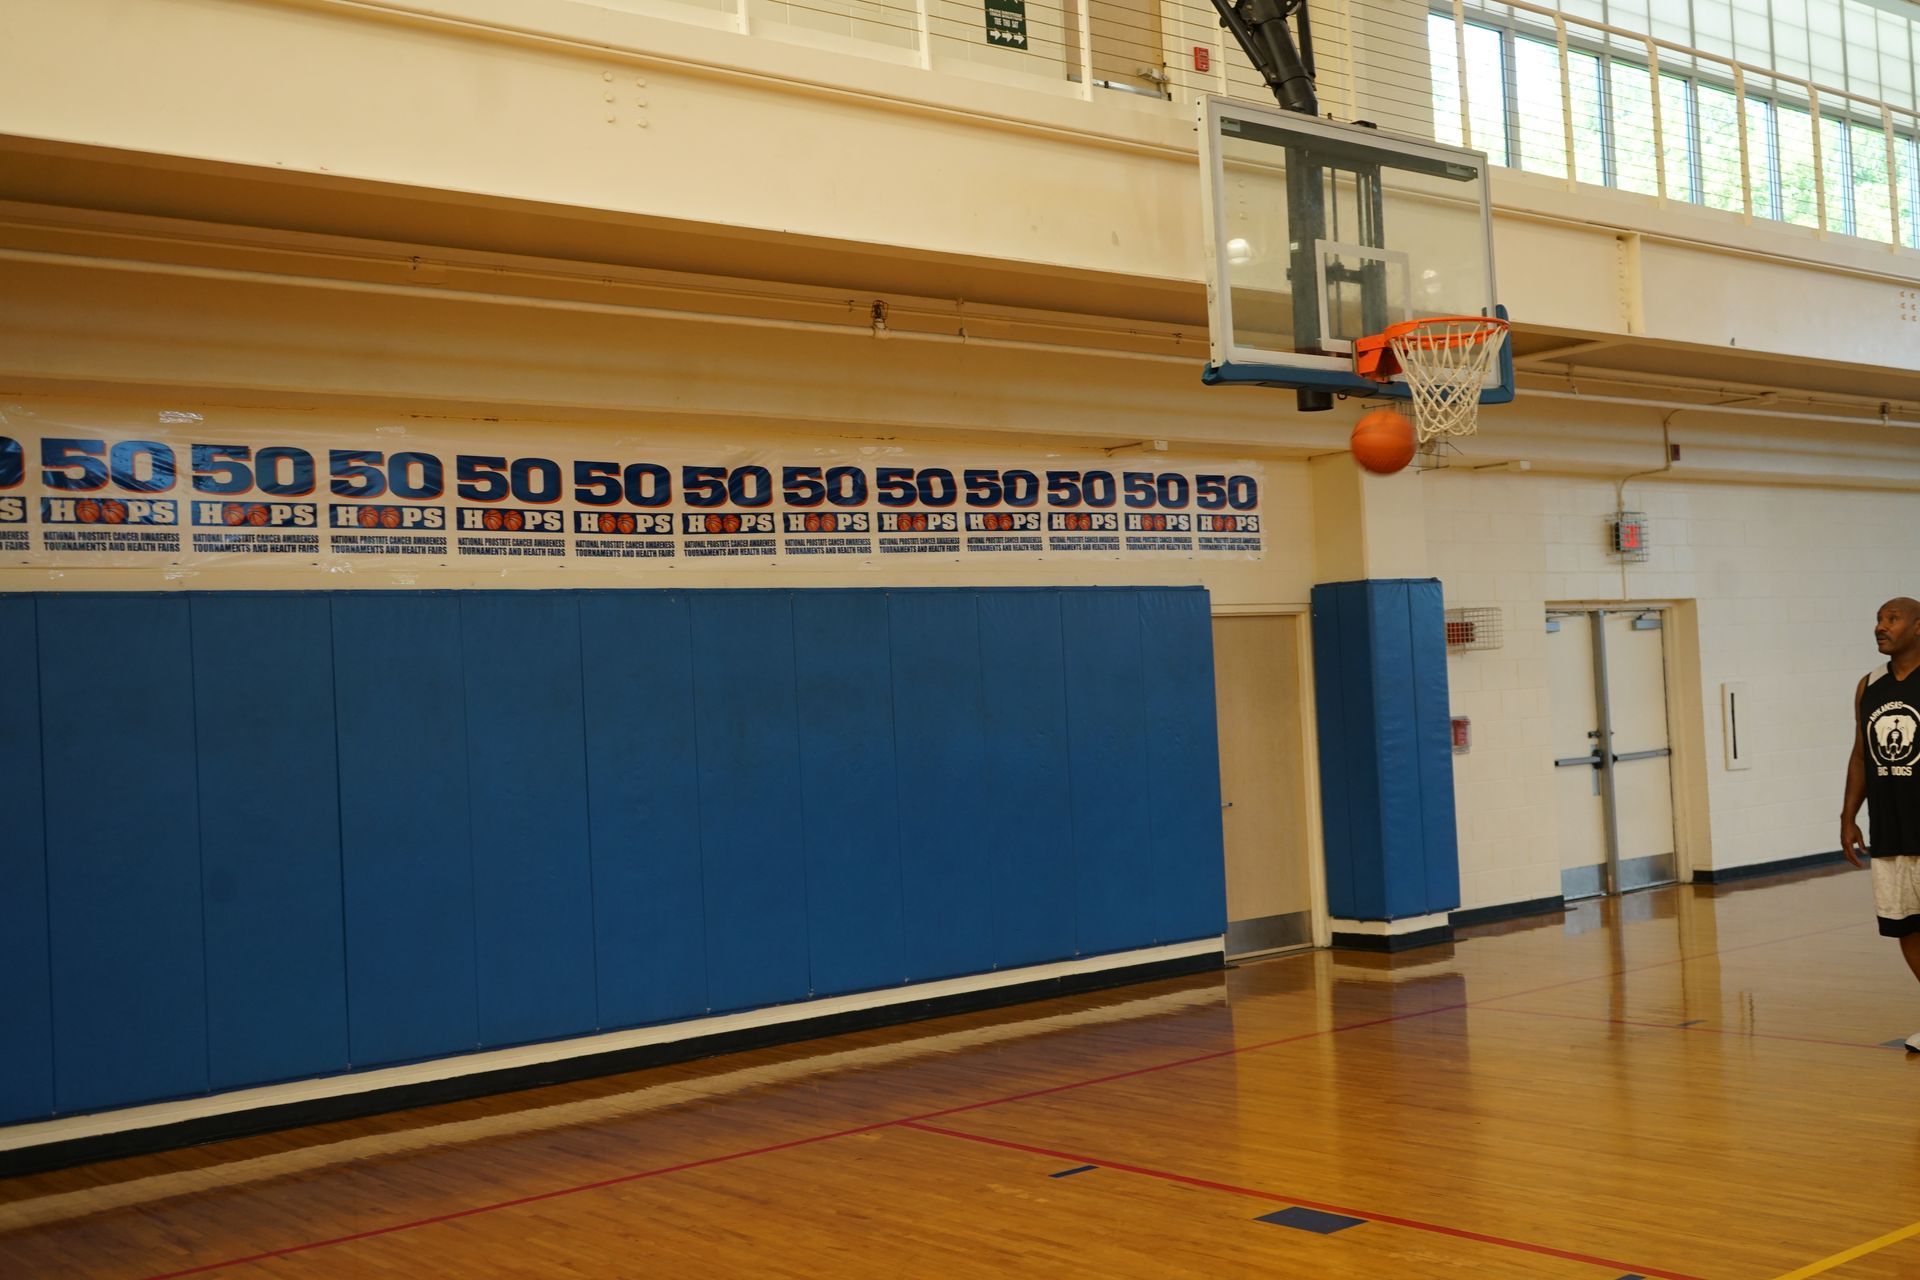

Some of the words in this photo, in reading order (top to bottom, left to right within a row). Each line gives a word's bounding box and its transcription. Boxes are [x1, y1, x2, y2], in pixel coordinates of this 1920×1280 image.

[41, 438, 177, 493] 50
[192, 444, 316, 497] 50
[329, 449, 444, 501] 50
[457, 455, 562, 504] 50
[574, 461, 672, 508] 50
[683, 465, 774, 508] 50
[783, 466, 869, 507] 50
[876, 467, 958, 508] 50
[965, 470, 1040, 508] 50
[1046, 470, 1116, 508] 50
[1123, 472, 1189, 509] 50
[1196, 474, 1258, 510] 50
[44, 542, 107, 551] TOURNAMENTS
[109, 543, 125, 551] AND
[128, 543, 156, 552] HEALTH
[158, 544, 180, 552] FAIRS
[193, 544, 252, 552] TOURNAMENTS
[255, 545, 270, 553] AND
[272, 545, 297, 553] HEALTH
[300, 545, 319, 553] FAIRS
[331, 545, 383, 553] TOURNAMENTS
[385, 546, 399, 554] AND
[401, 546, 425, 554] HEALTH
[459, 547, 508, 555] TOURNAMENTS
[510, 548, 522, 556] AND
[524, 548, 546, 556] HEALTH
[548, 548, 565, 556] FAIRS
[685, 549, 725, 557] TOURNAMENTS
[739, 548, 758, 556] HEALTH
[1869, 701, 1904, 722] ARKANSAS
